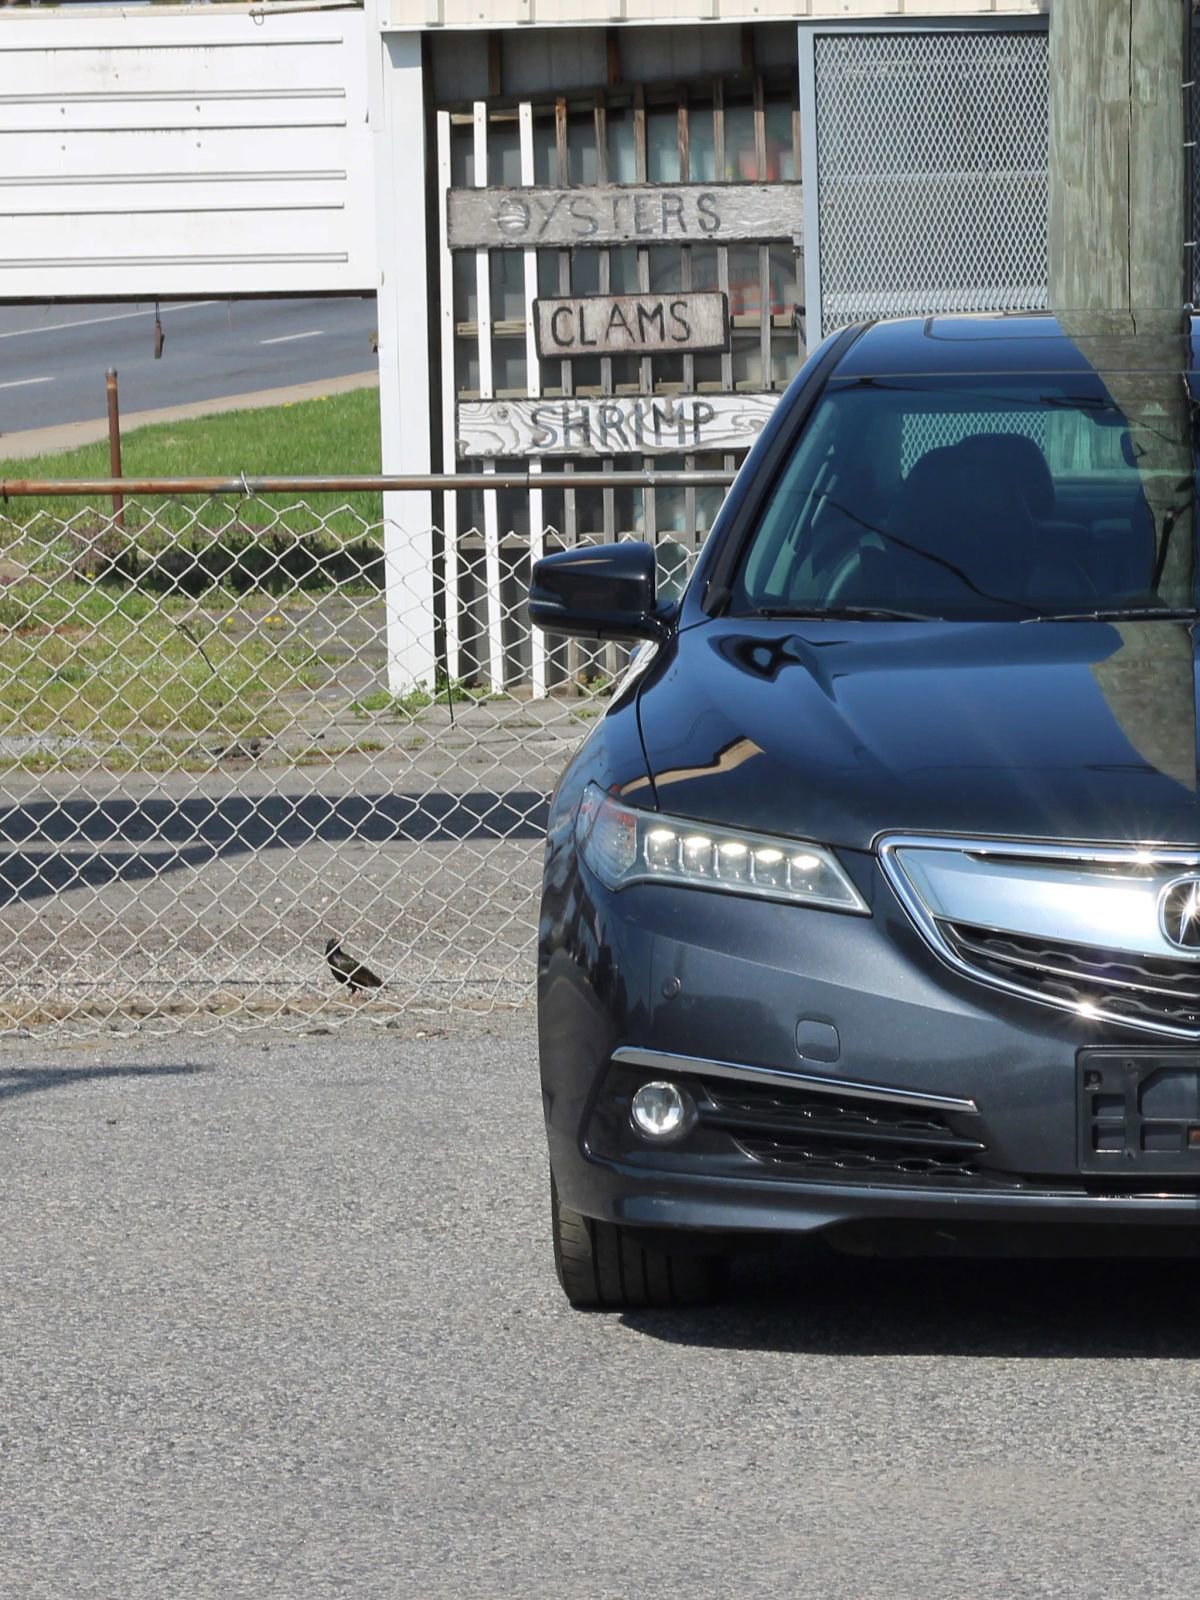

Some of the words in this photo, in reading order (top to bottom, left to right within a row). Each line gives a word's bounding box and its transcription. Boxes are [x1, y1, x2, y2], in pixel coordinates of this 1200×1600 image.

[496, 192, 722, 236] OYSTERS
[550, 301, 692, 347] CLAMS
[531, 401, 715, 449] SHRIMP
